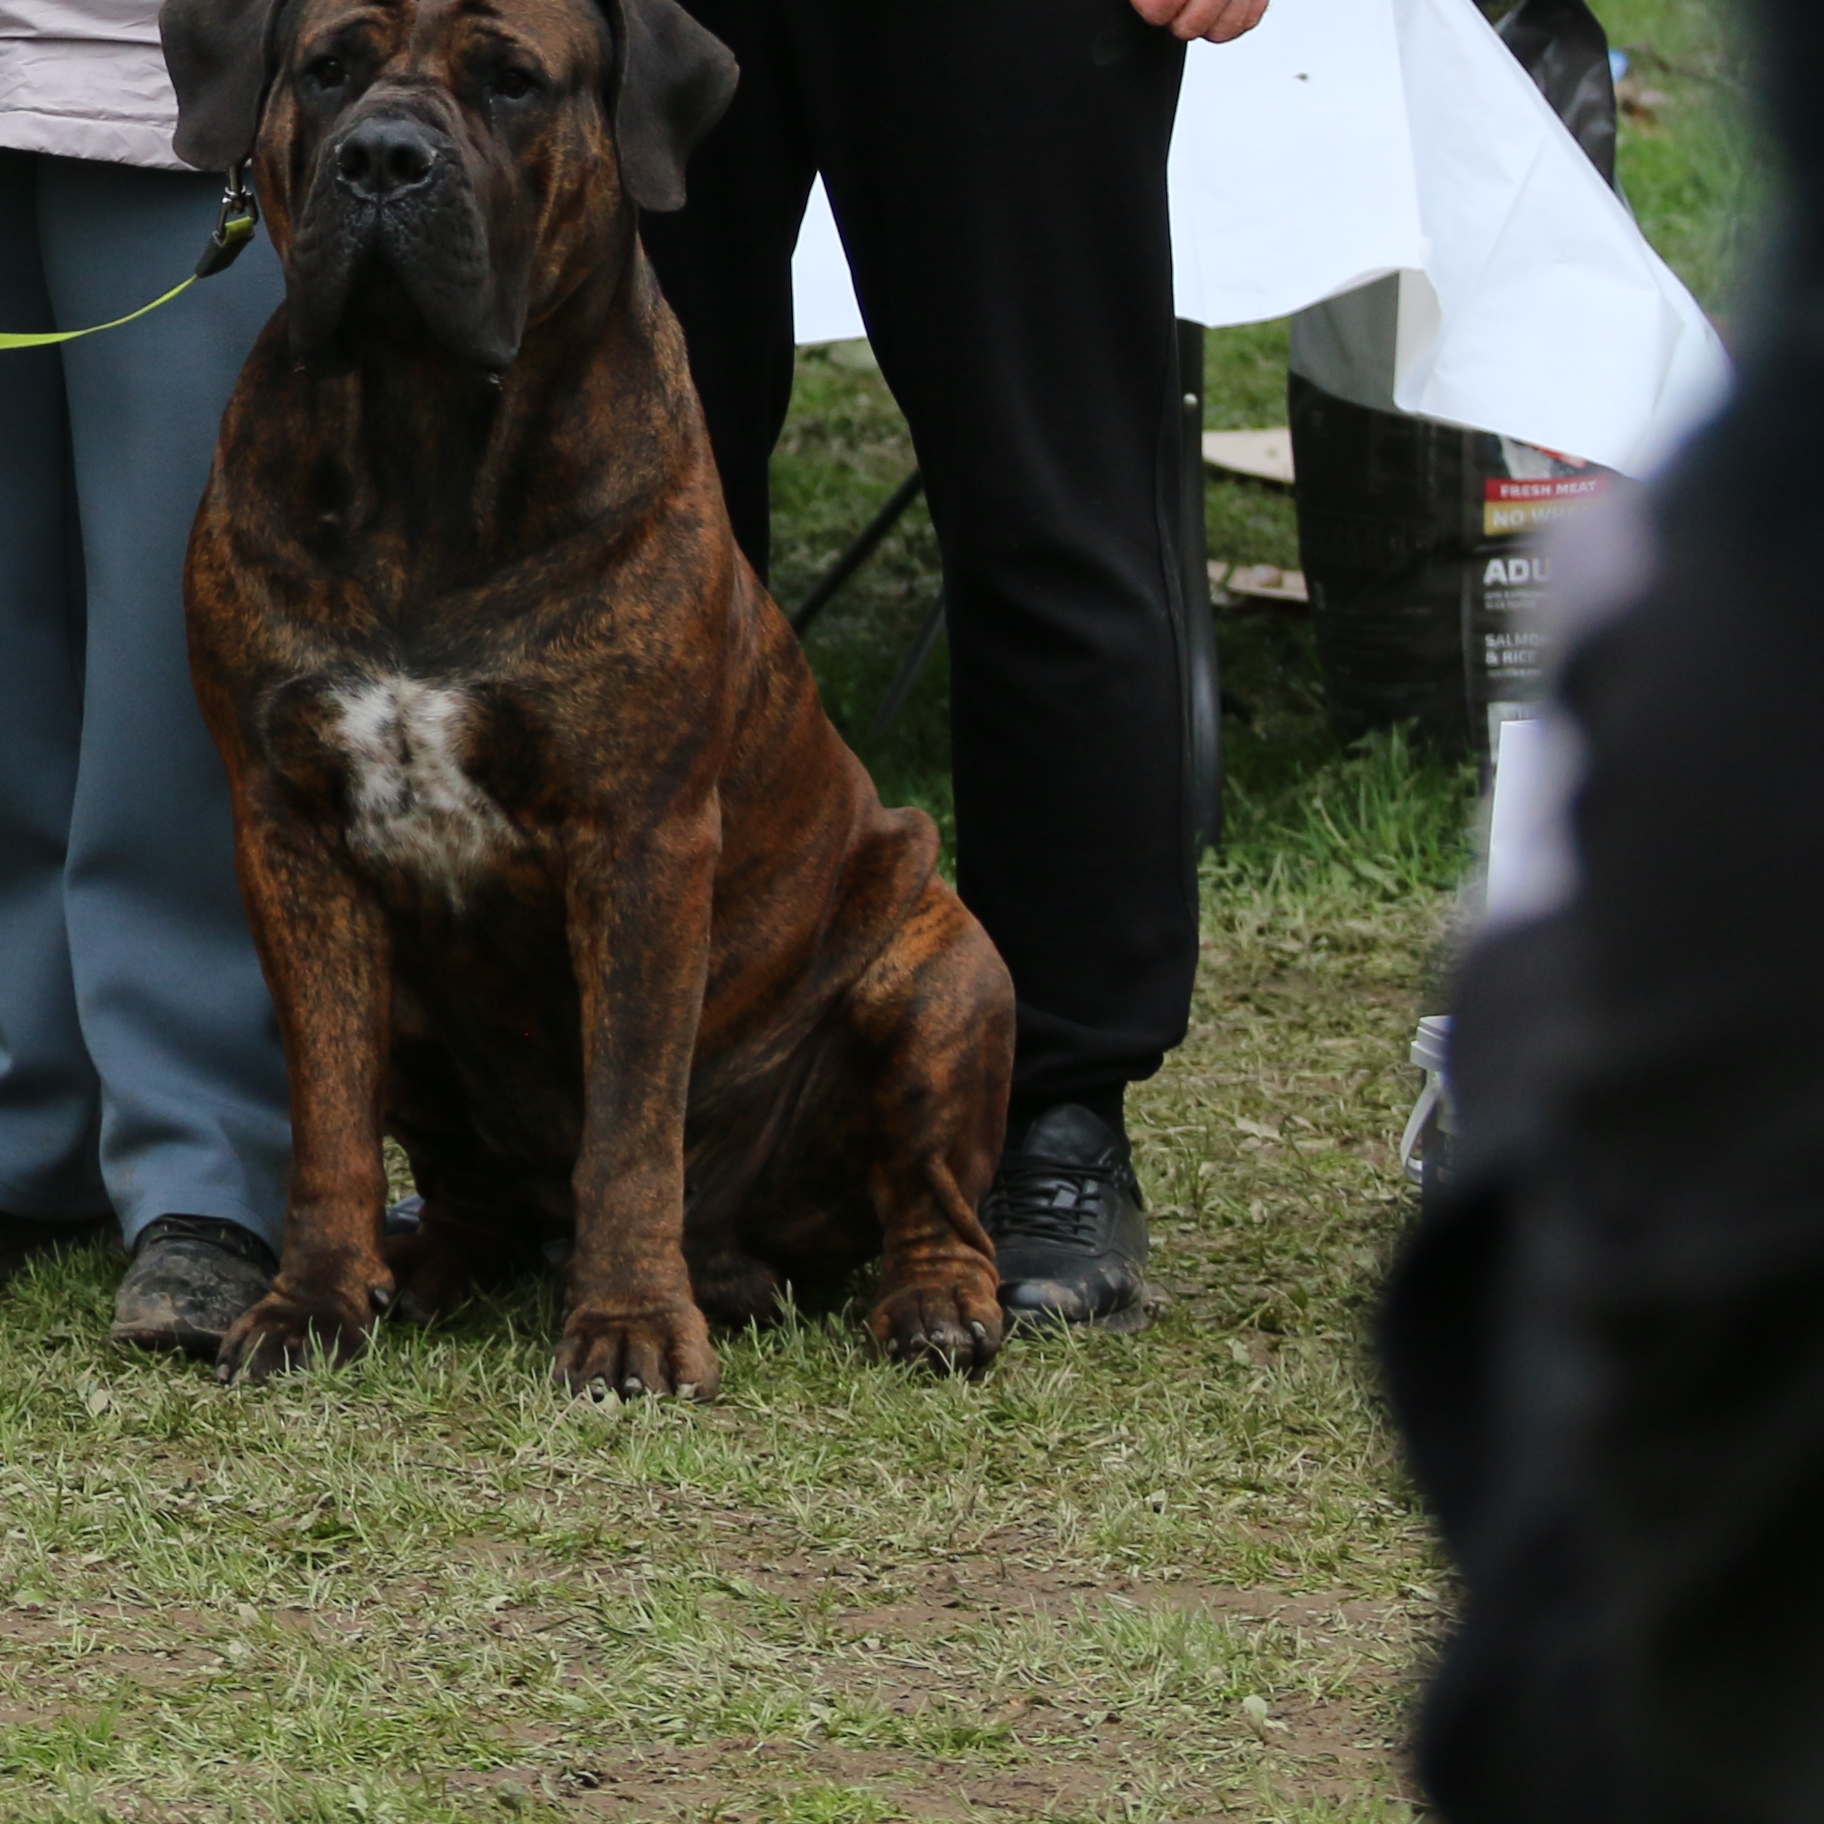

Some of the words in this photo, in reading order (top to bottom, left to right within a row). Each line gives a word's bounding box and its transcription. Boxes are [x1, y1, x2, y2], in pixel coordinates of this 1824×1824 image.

[1499, 483, 1552, 499] FRESH
[1555, 480, 1596, 495] MEAT
[1493, 509, 1526, 528] NO
